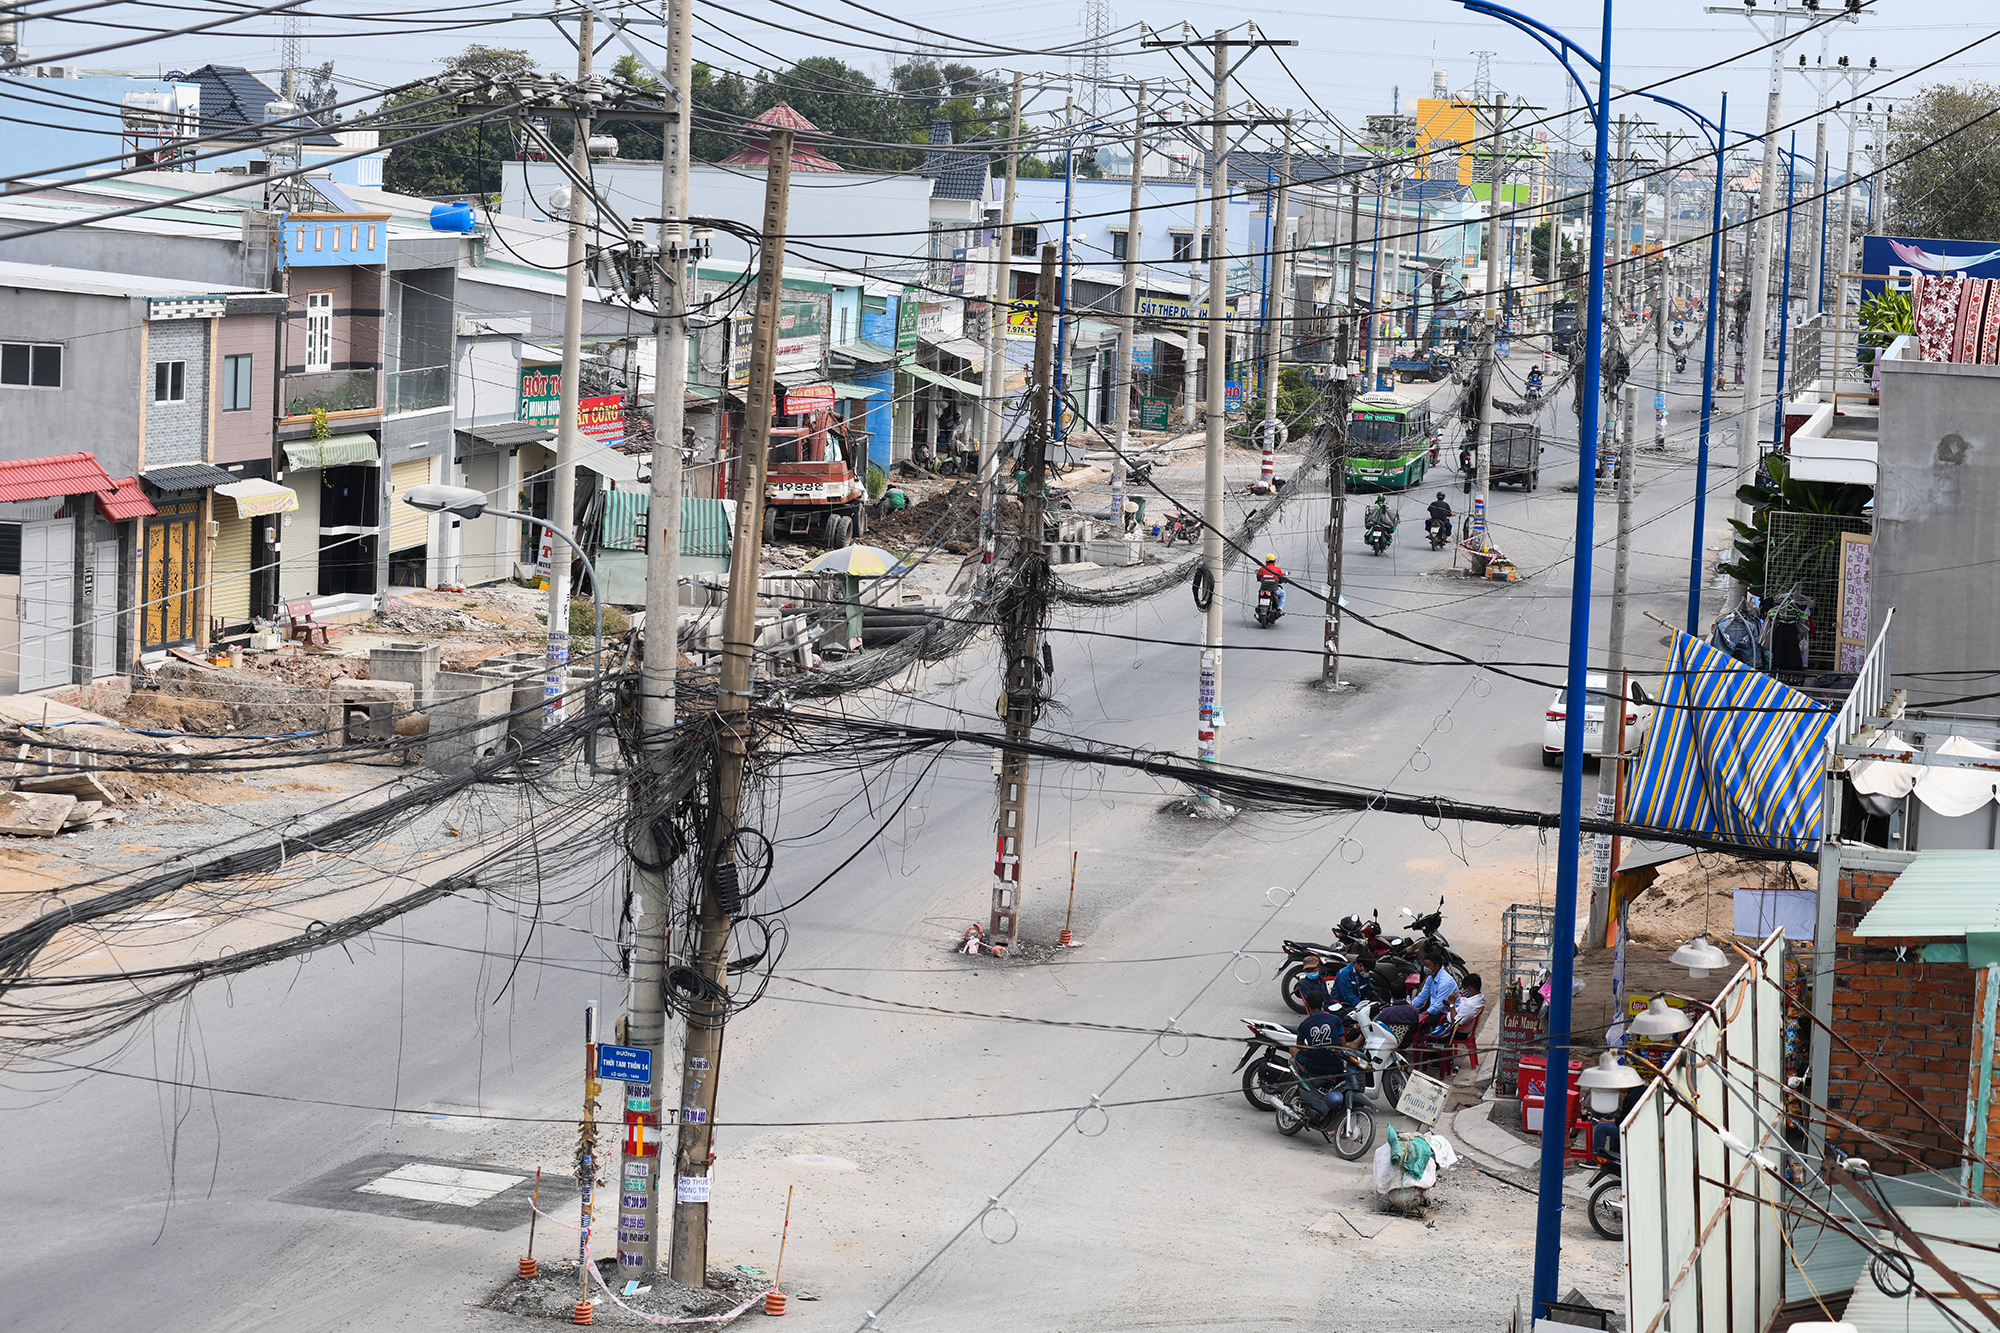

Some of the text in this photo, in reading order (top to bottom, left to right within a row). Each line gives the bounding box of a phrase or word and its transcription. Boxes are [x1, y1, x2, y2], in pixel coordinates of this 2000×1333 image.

[1159, 302, 1179, 318] THÉP
[1632, 1002, 1647, 1010] Lay's
[1504, 1015, 1518, 1028] Café
[1520, 1017, 1538, 1032] Mang
[1310, 1024, 1332, 1047] 22
